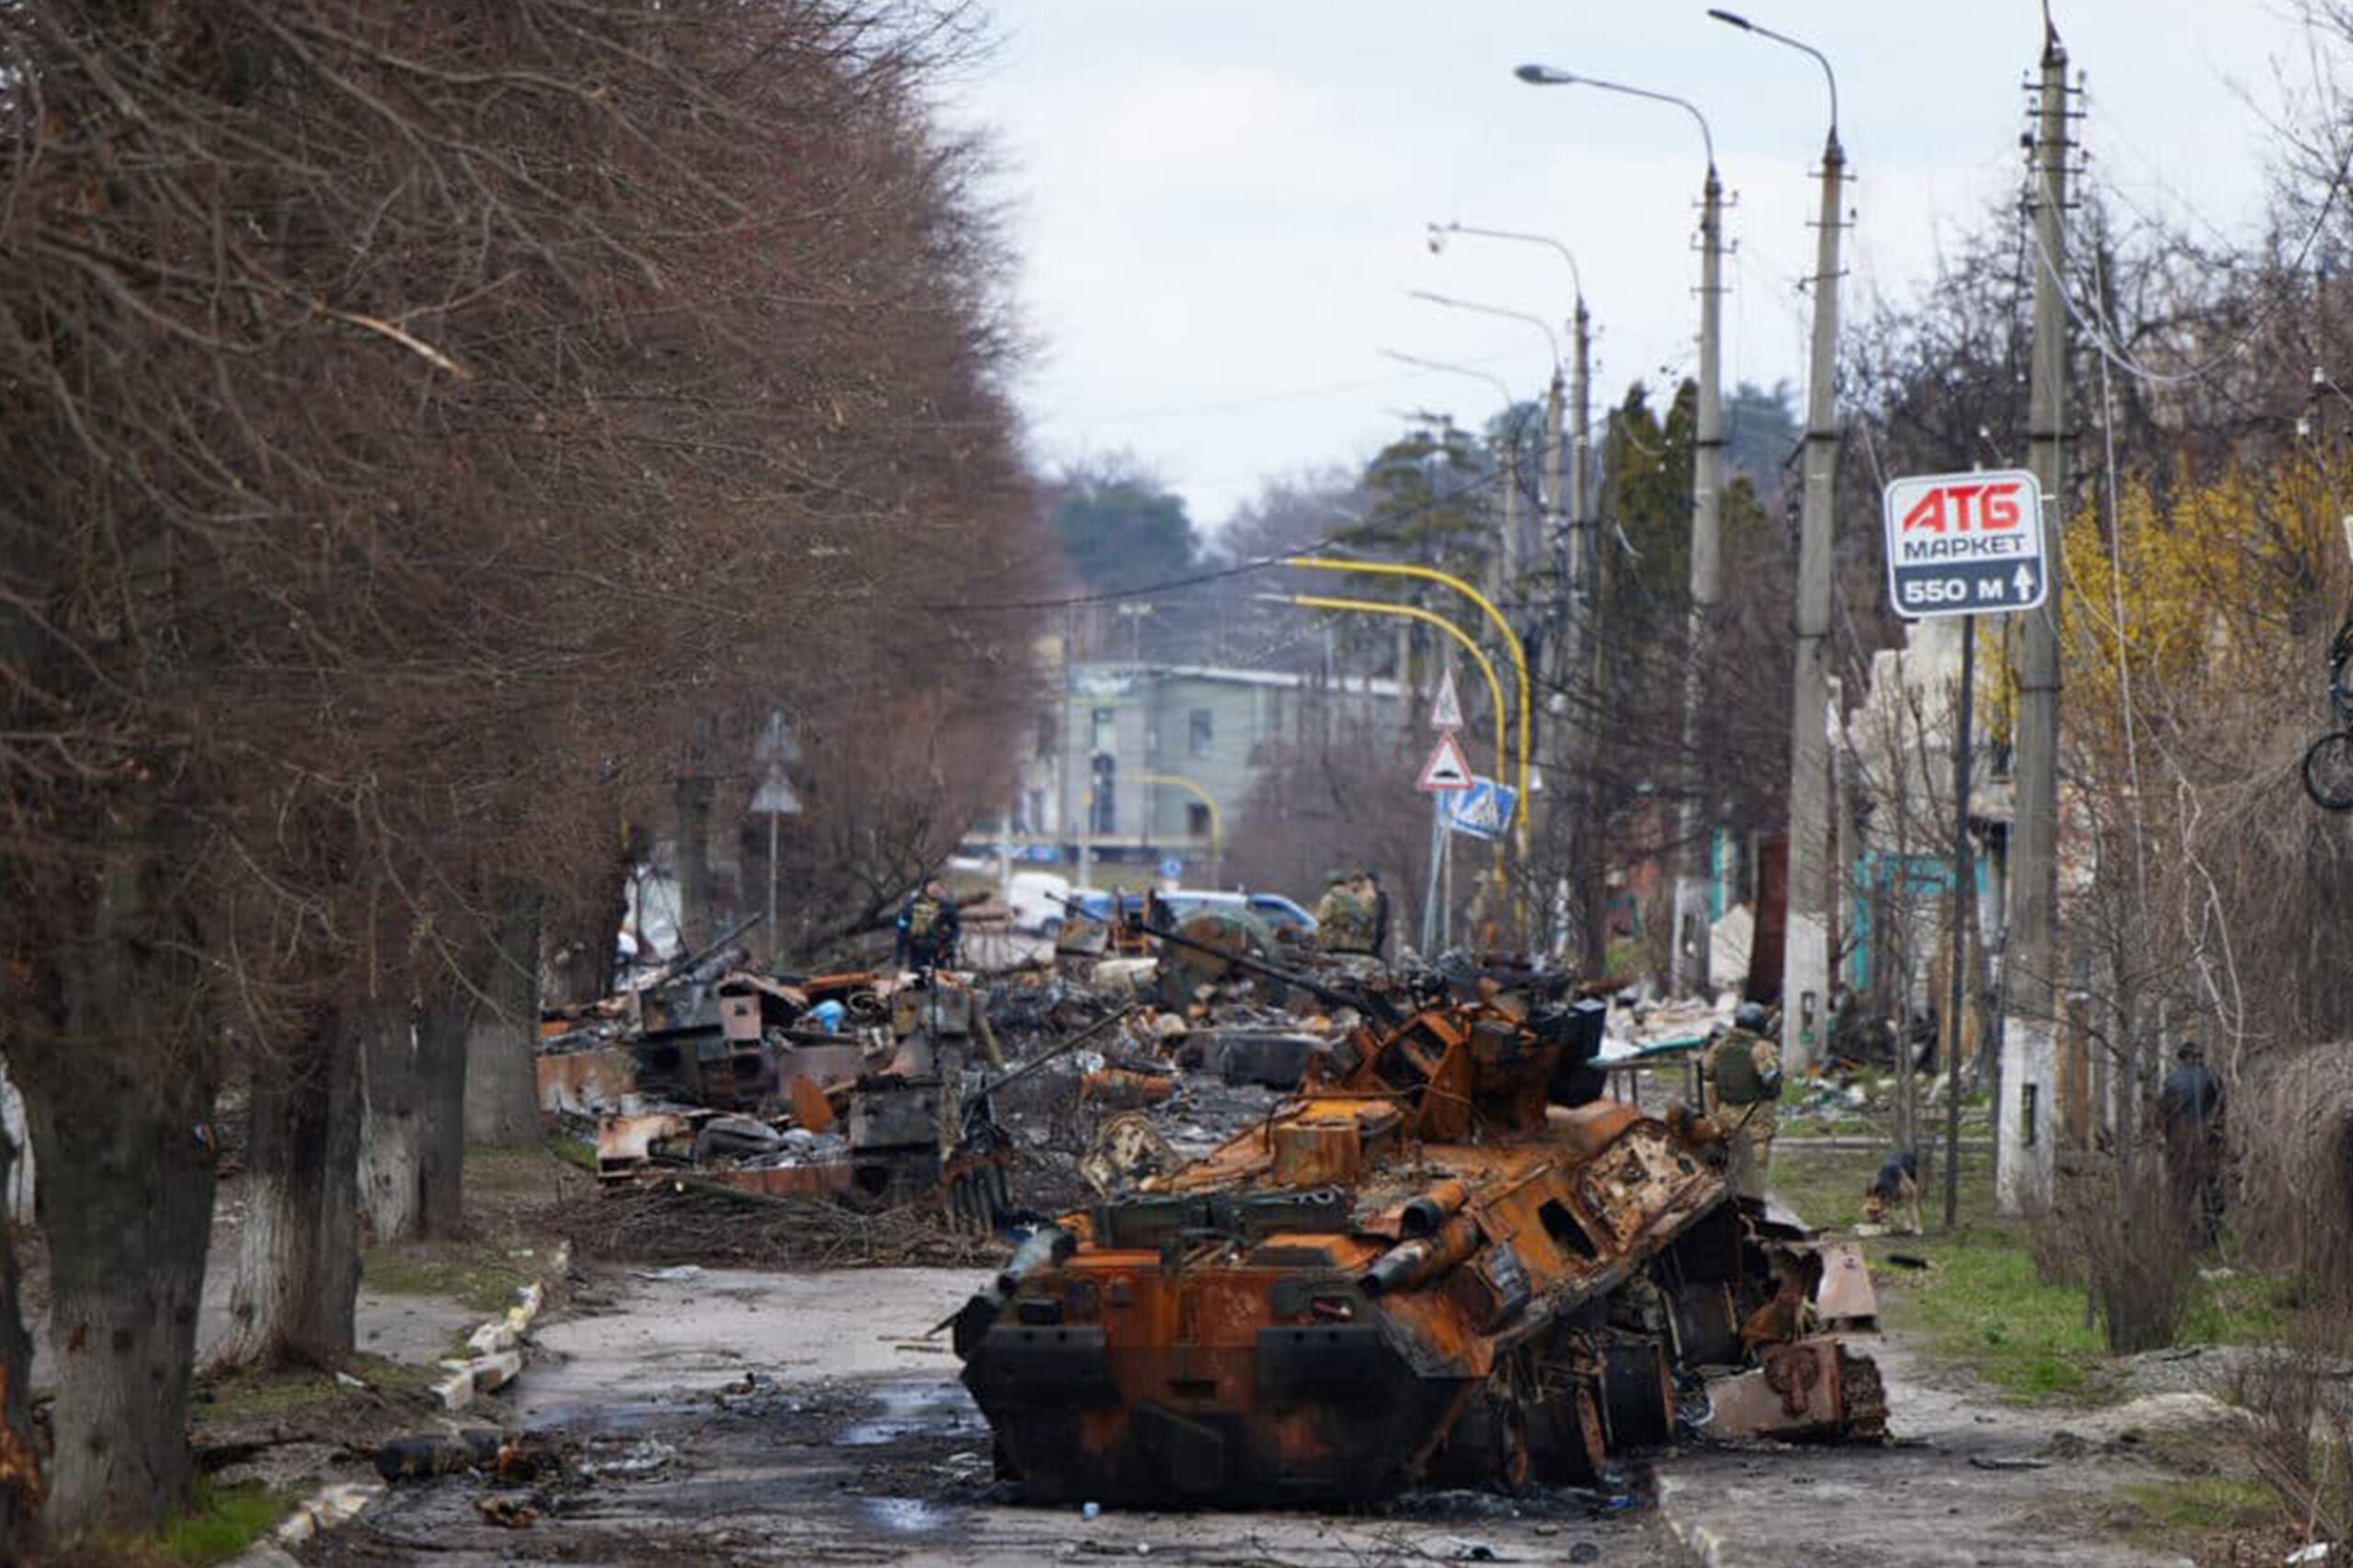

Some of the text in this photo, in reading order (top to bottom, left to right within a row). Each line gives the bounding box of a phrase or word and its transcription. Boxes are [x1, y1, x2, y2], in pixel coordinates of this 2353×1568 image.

[1903, 483, 2022, 532] АТБ
[1904, 533, 2026, 560] МАРКЕТ
[1904, 578, 1967, 603] 550
